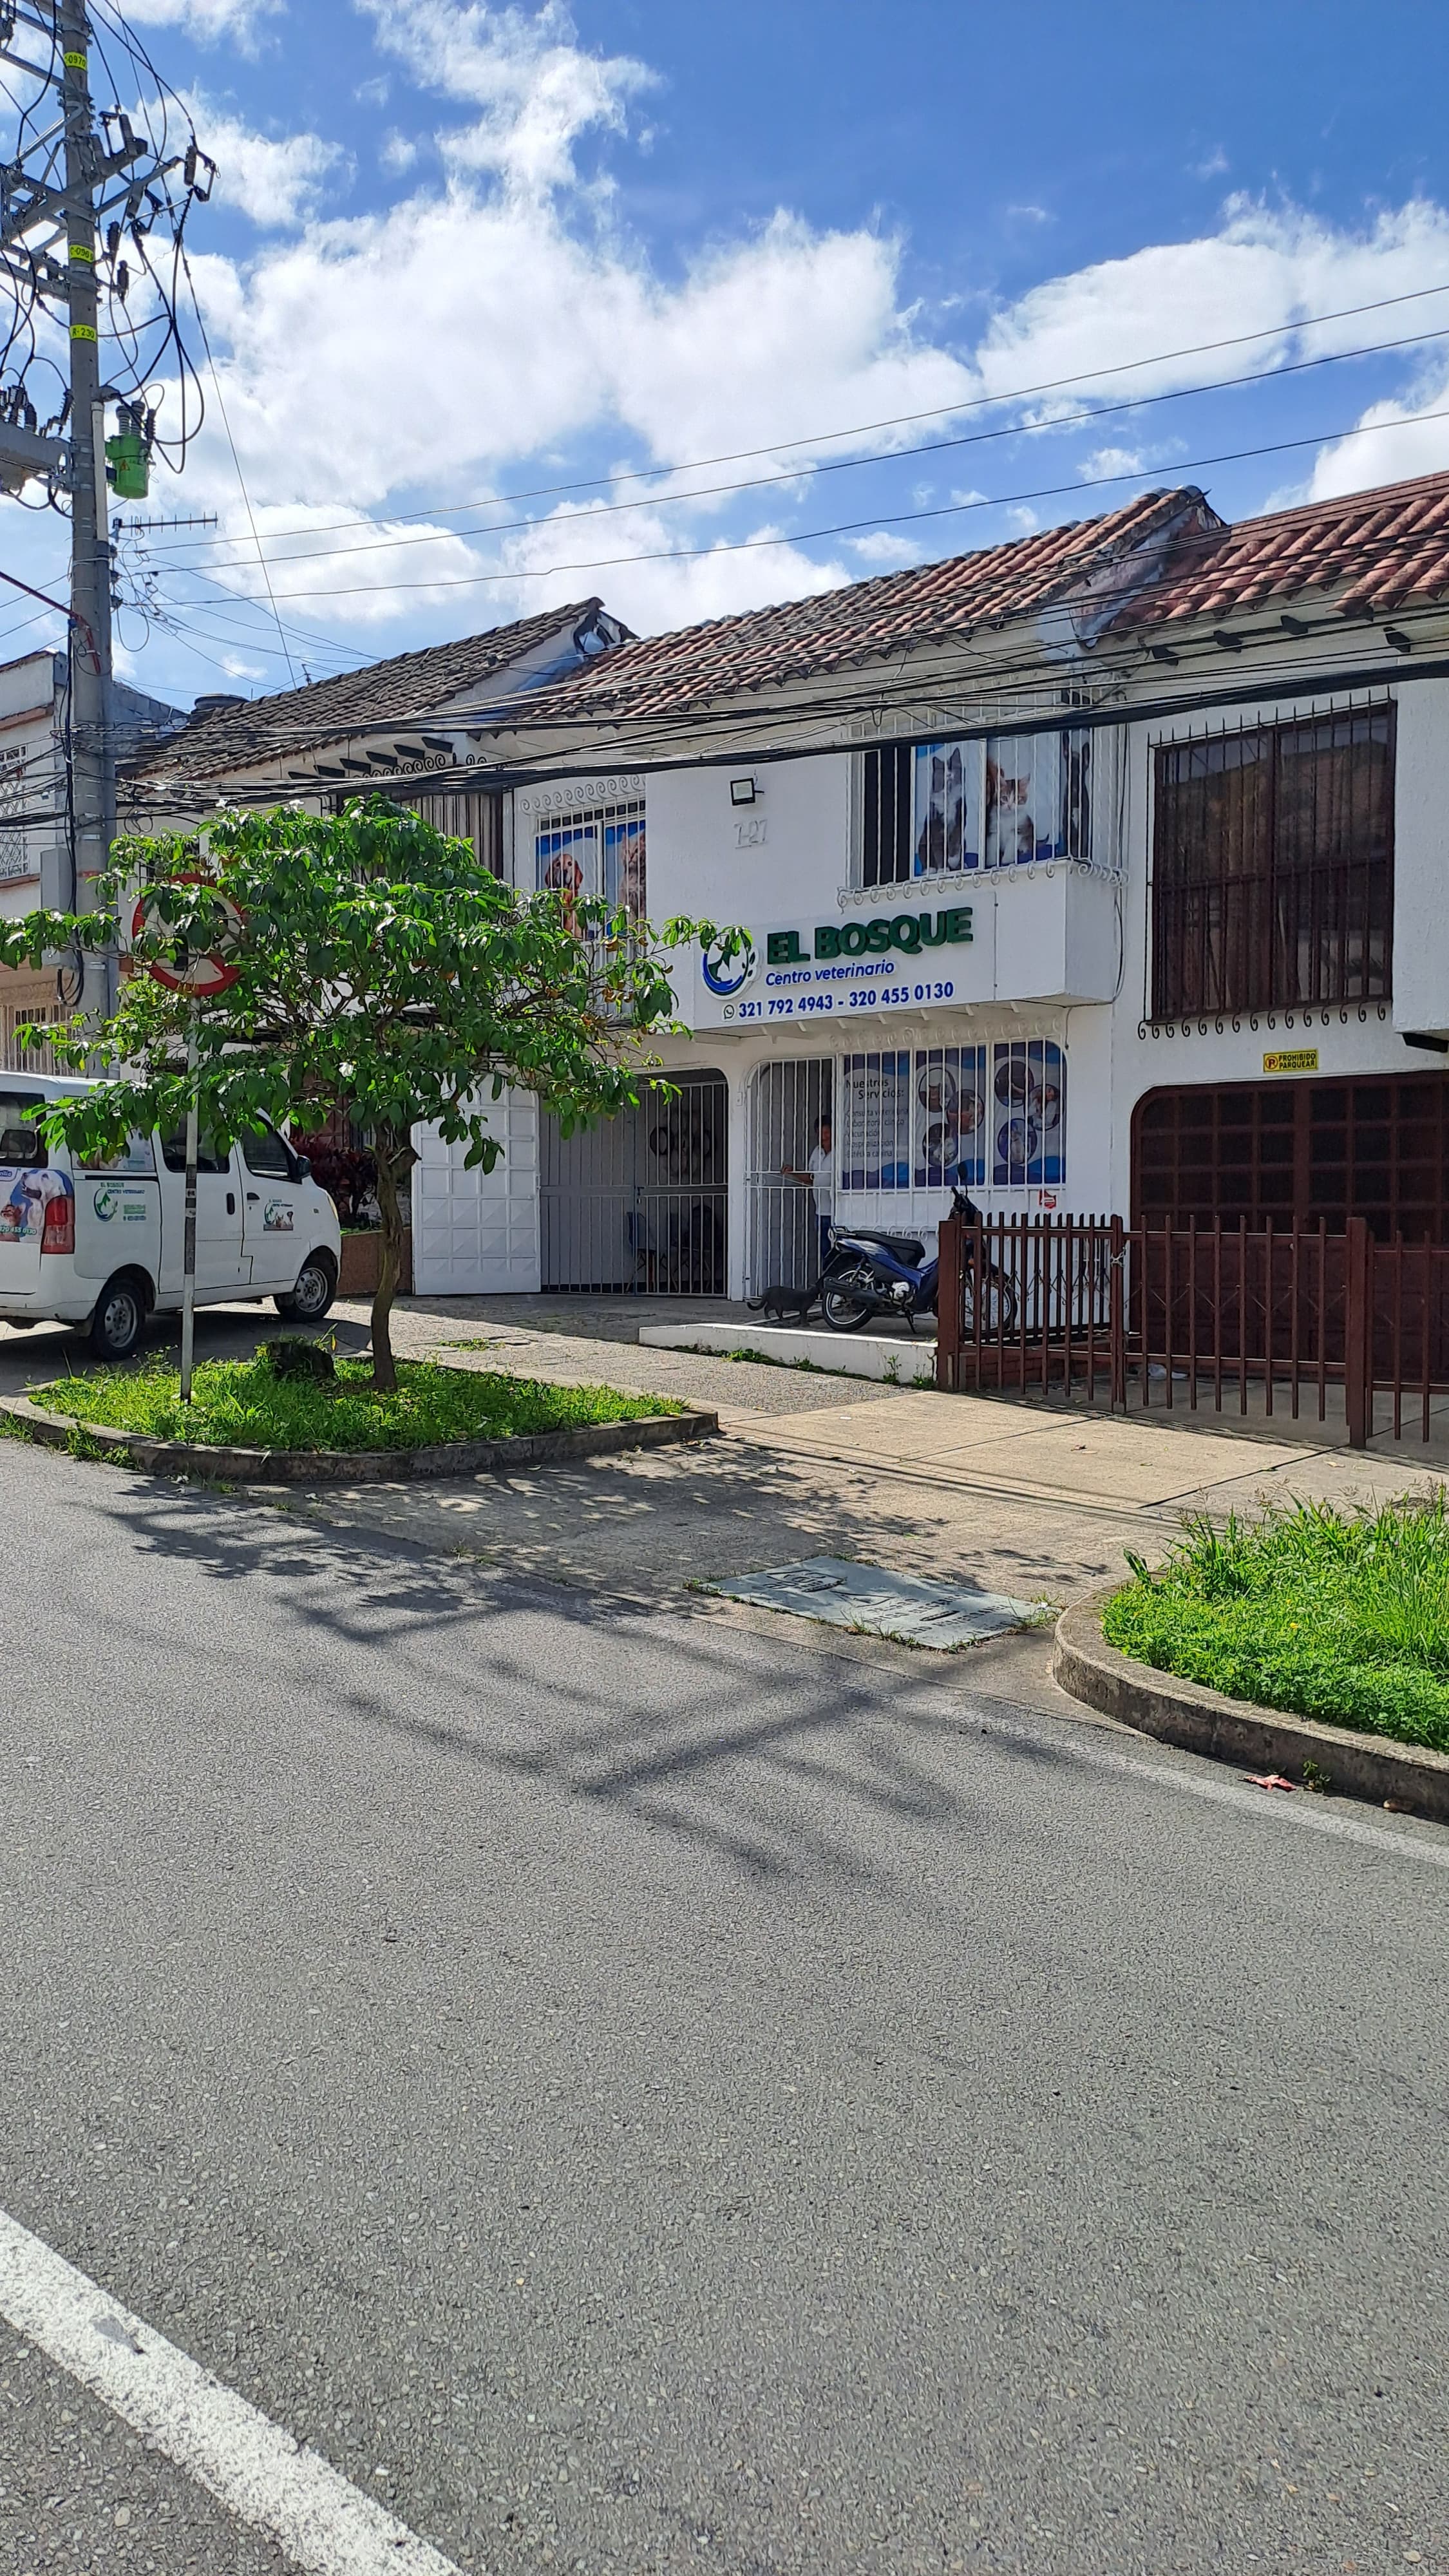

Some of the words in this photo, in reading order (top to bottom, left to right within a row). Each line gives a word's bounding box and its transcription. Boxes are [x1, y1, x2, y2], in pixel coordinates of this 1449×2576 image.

[767, 931, 811, 965] EL
[815, 907, 974, 960] BOSQUE
[766, 970, 811, 986] Centro
[815, 959, 895, 981] veterinario
[739, 1002, 762, 1018] 321
[768, 999, 793, 1015] 792
[798, 994, 833, 1012] 4943
[849, 990, 876, 1007] 320
[881, 987, 909, 1004] 455
[914, 981, 954, 999] 0130
[1278, 1053, 1316, 1062] PROHIBIDO
[1279, 1060, 1315, 1069] PARQUEAR
[858, 1088, 904, 1100] Servcios:
